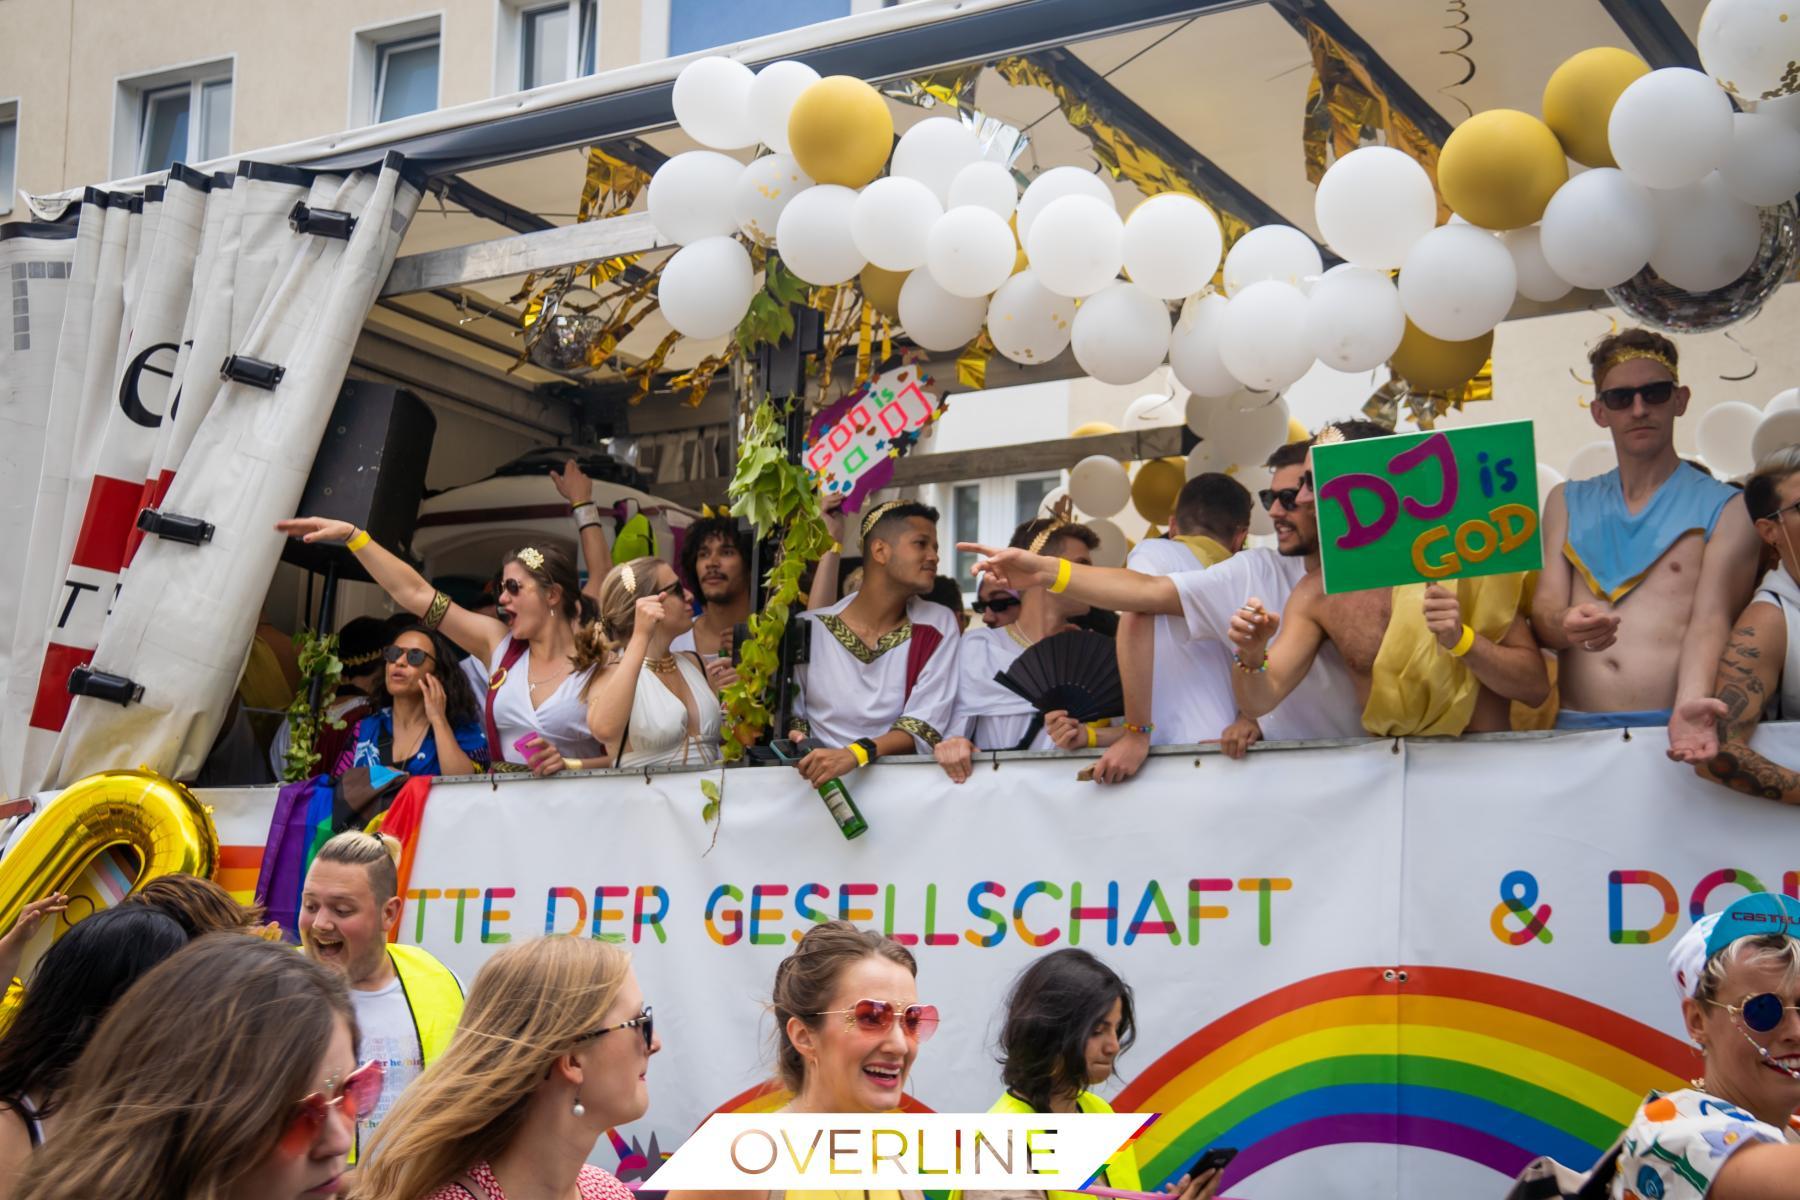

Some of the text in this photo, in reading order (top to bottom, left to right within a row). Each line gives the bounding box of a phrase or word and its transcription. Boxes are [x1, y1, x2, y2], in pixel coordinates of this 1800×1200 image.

[873, 388, 904, 408] is
[878, 382, 932, 437] DJ
[1319, 432, 1517, 550] DJ is
[1411, 503, 1537, 578] GOD
[545, 885, 670, 944] DER
[704, 878, 1292, 947] GESELLSCHAFT
[1490, 870, 1553, 945] &
[1608, 868, 1800, 944] DO
